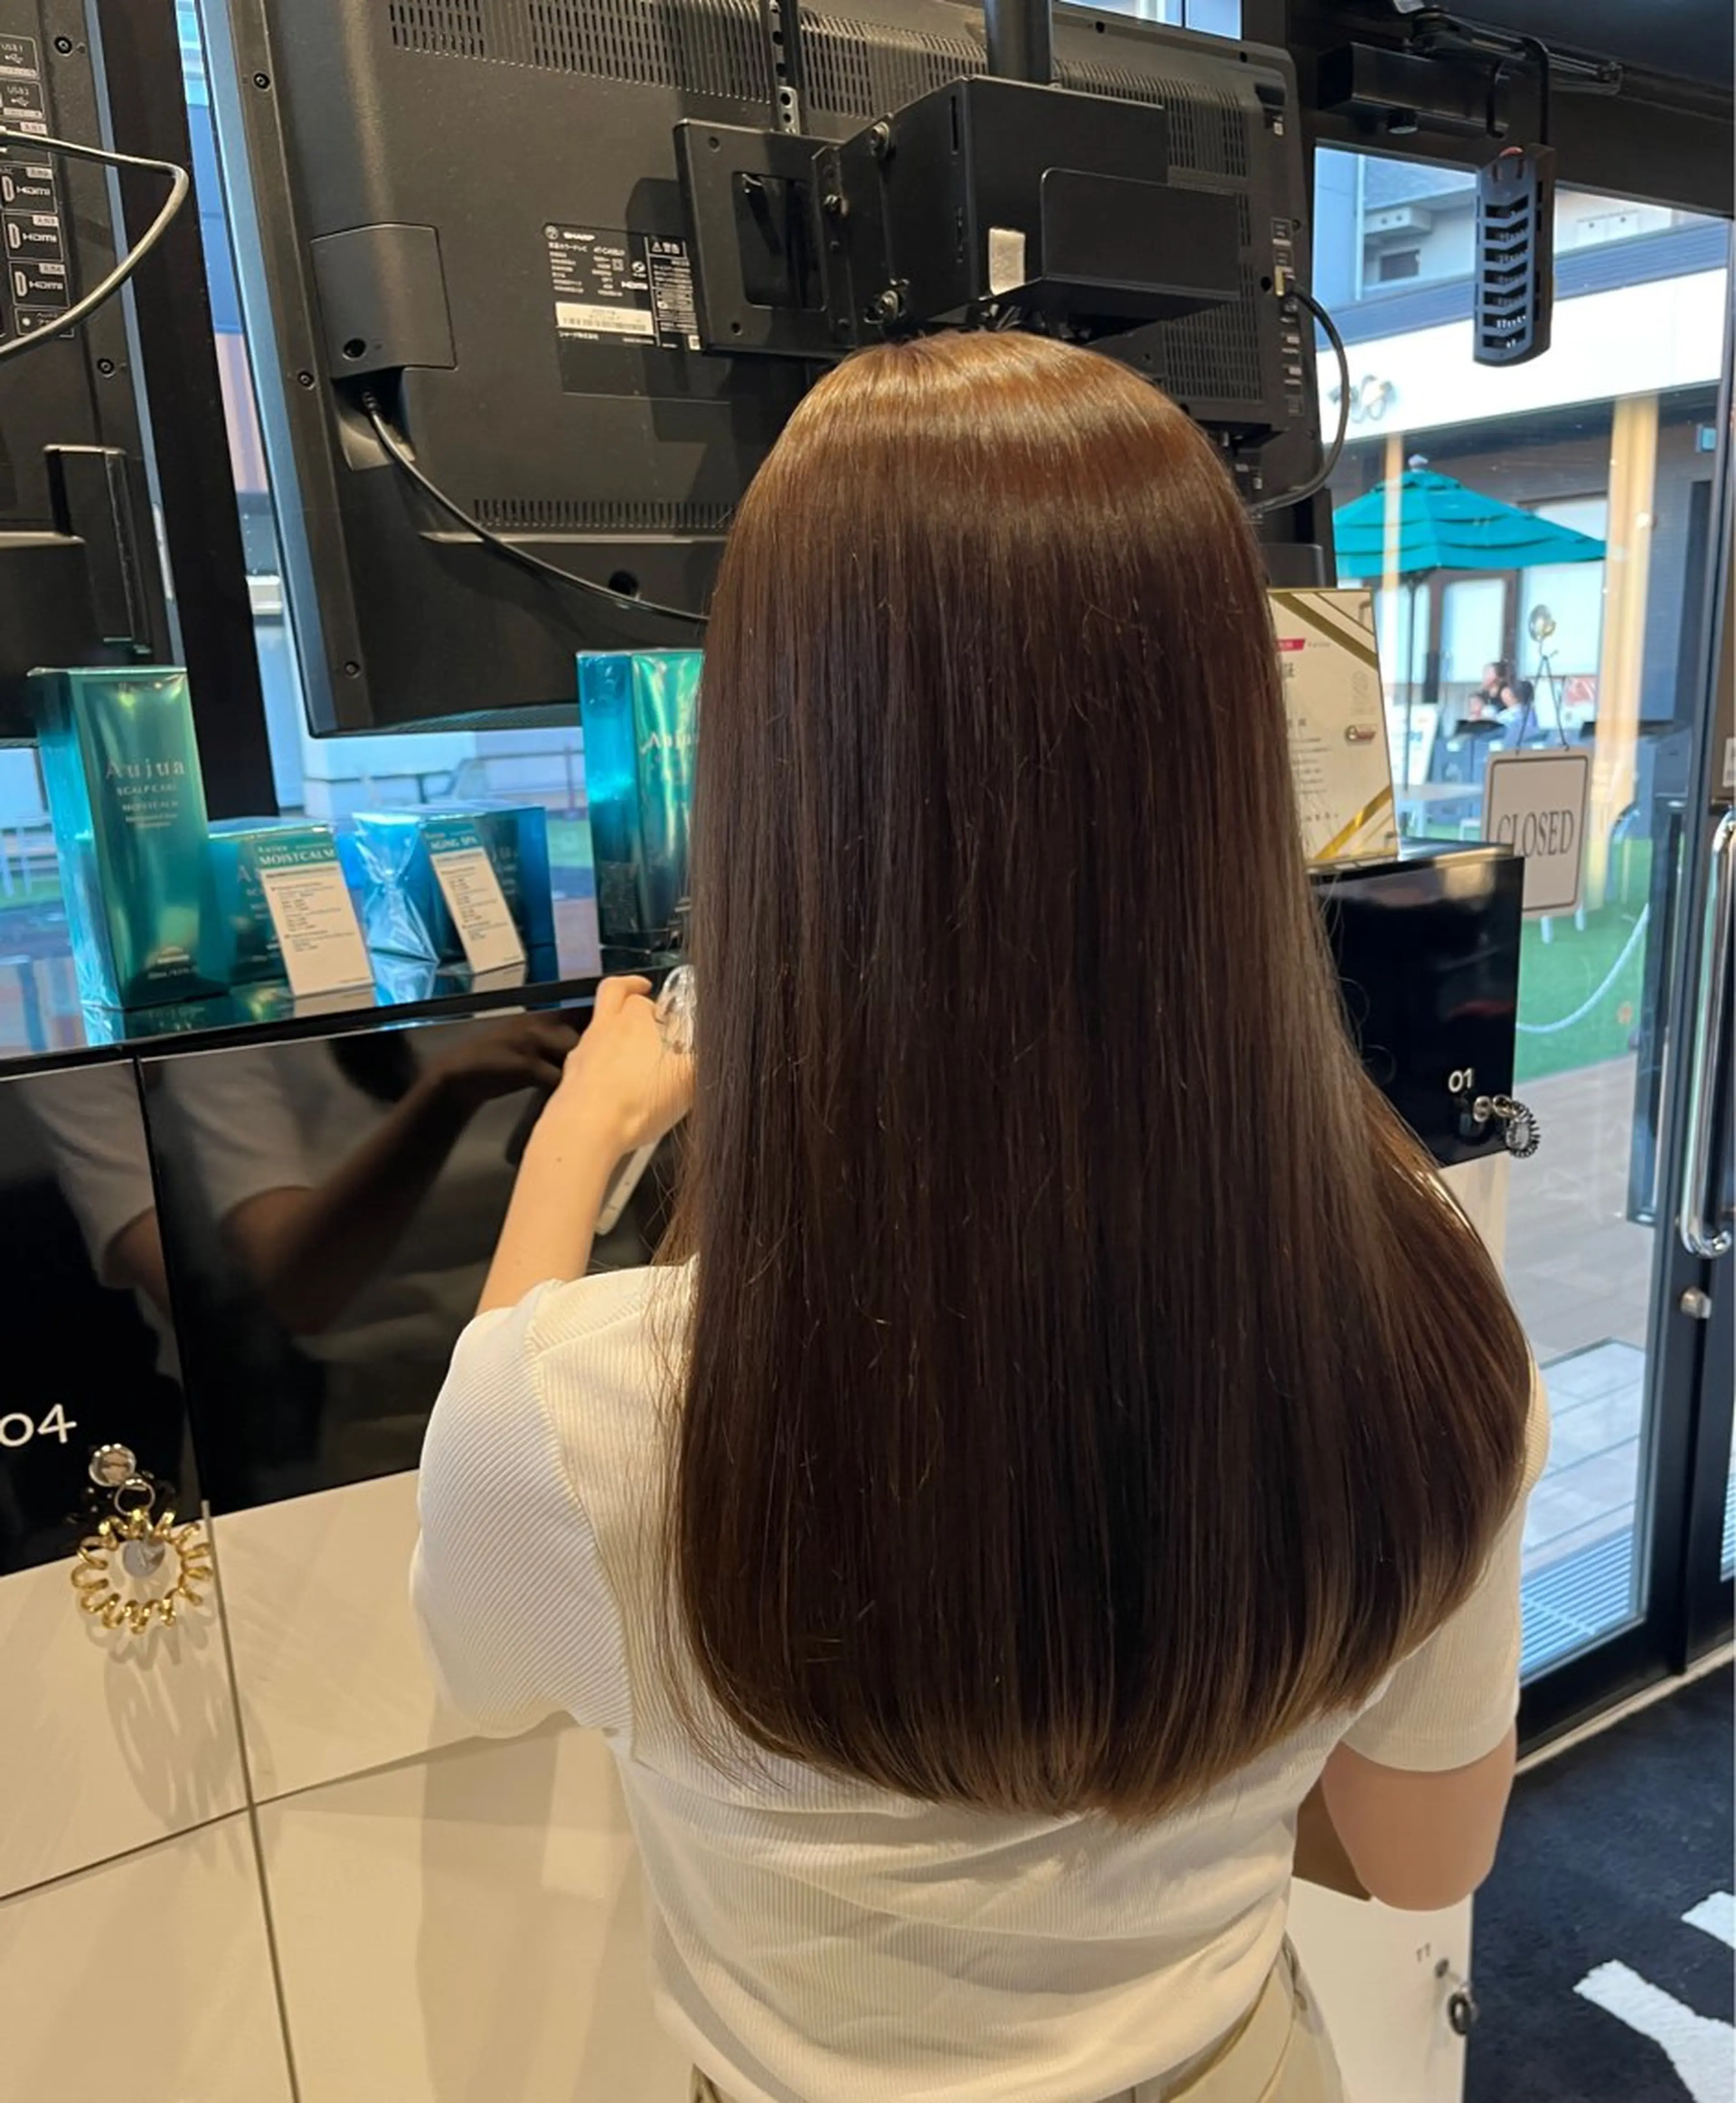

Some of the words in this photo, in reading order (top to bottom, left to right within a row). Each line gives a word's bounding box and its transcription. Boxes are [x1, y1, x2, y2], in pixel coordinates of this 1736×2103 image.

[16, 186, 51, 195] HDMI
[23, 232, 57, 242] HDMI
[29, 280, 64, 290] HDMI
[105, 757, 185, 780] Aujua
[1496, 809, 1575, 858] CLOSED
[1448, 1068, 1473, 1093] 01
[0, 1403, 77, 1447] 04
